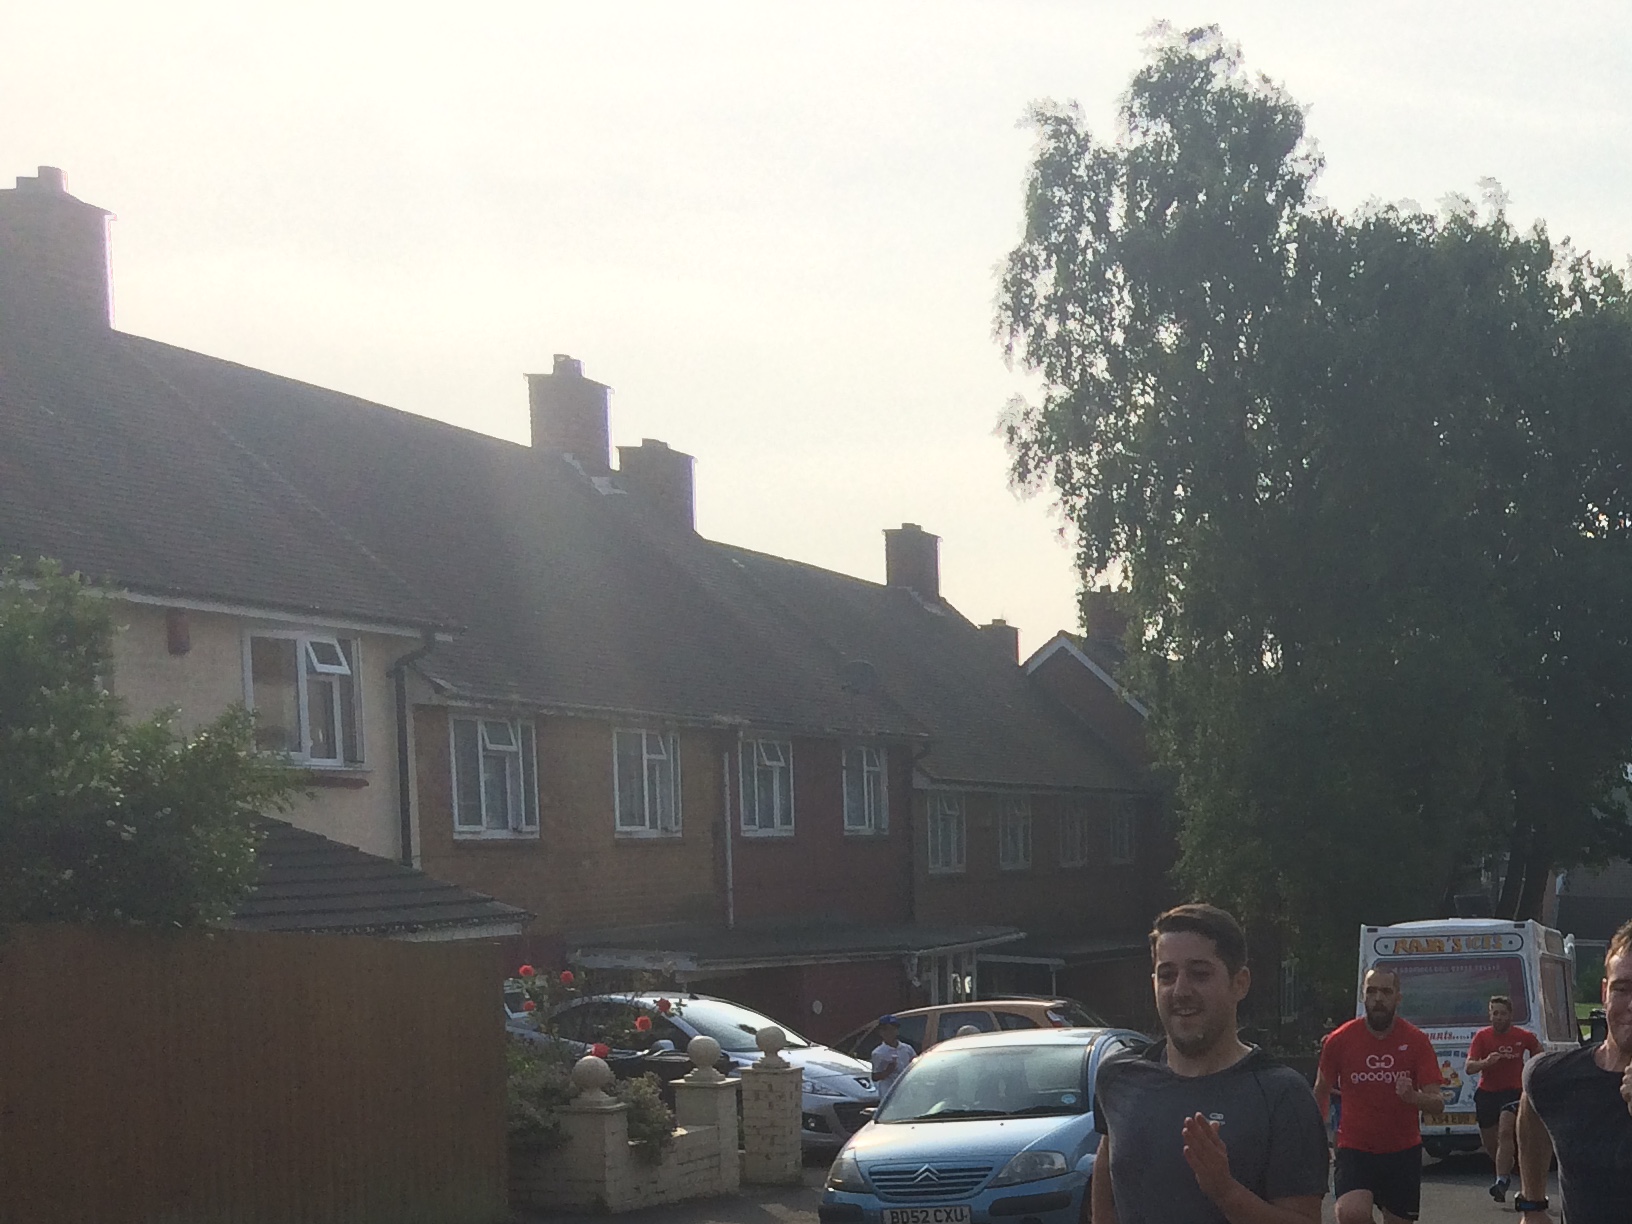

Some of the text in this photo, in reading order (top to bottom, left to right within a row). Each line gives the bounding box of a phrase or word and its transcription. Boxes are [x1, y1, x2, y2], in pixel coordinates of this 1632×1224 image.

[1465, 934, 1503, 950] ICES
[890, 1208, 965, 1224] BD52 CXU
